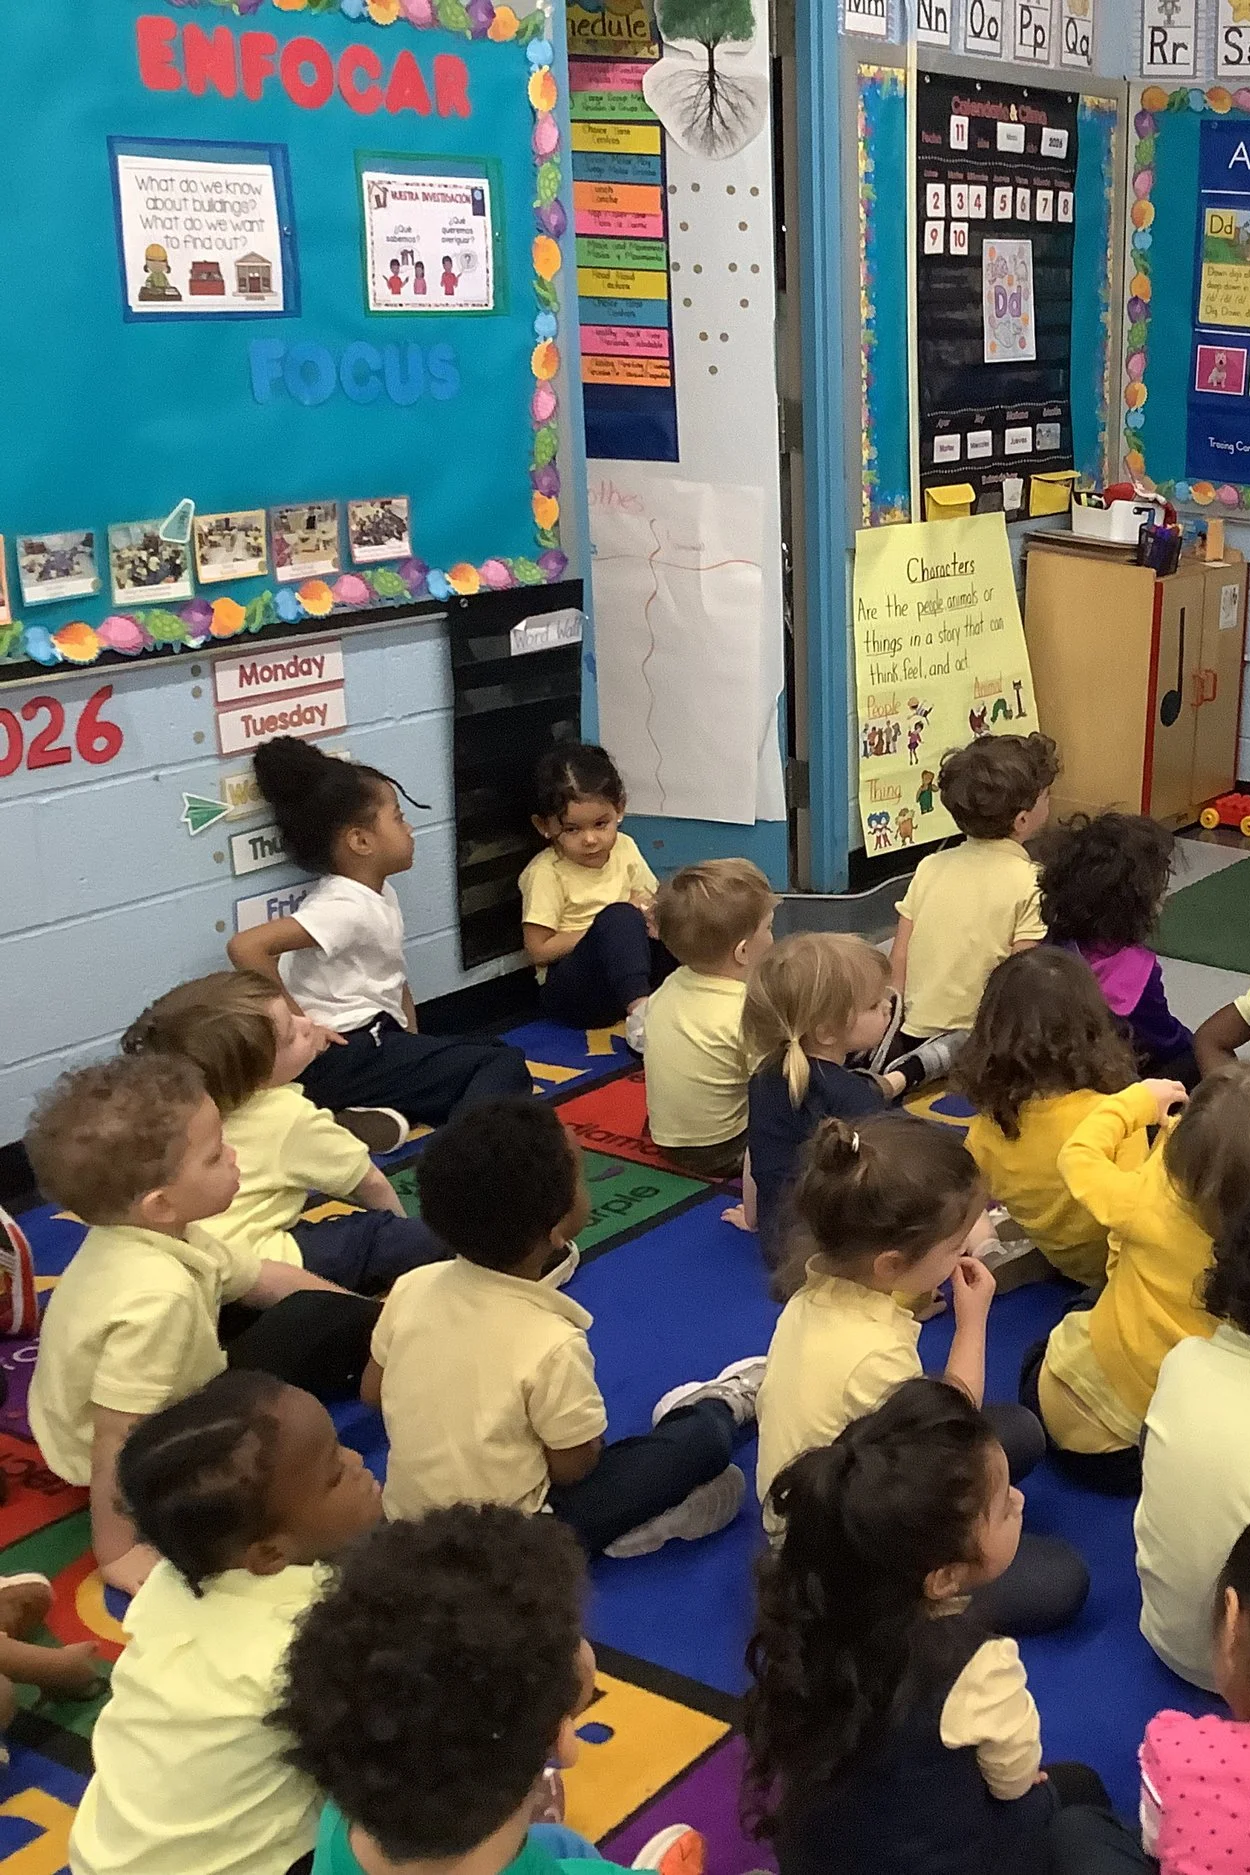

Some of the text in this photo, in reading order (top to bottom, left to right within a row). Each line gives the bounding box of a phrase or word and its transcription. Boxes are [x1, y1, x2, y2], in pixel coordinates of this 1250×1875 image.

[917, 0, 948, 33] Nn
[970, 0, 998, 39] Oo
[1020, 6, 1045, 57] Pp
[1066, 18, 1092, 65] Qq
[1150, 27, 1188, 65] Rr
[136, 15, 471, 118] ENFOCAR
[955, 124, 964, 142] 11
[135, 175, 262, 196] What do we know
[146, 196, 257, 217] about buildings?
[932, 192, 940, 210] 2
[956, 192, 964, 211] 3
[974, 193, 982, 211] 4
[999, 193, 1007, 211] 5
[1020, 194, 1026, 212] 6
[1042, 197, 1049, 214] 7
[1062, 199, 1069, 215] 8
[140, 214, 265, 232] What do we want
[1209, 214, 1234, 236] Dd
[164, 234, 248, 250] to find out?
[930, 228, 938, 245] 9
[953, 229, 966, 248] 10
[994, 285, 1021, 318] Dd
[248, 338, 462, 406] FOCUS
[1208, 437, 1234, 455] Tracing
[906, 552, 975, 583] Characters
[857, 598, 878, 622] Are
[886, 594, 908, 618] the
[983, 587, 994, 602] or
[863, 611, 1004, 658] things in a story that can
[238, 650, 325, 689] Monday
[929, 652, 950, 676] and
[955, 648, 969, 671] act
[867, 692, 901, 720] People
[0, 685, 123, 778] 026
[240, 700, 328, 739] Tuesday
[865, 778, 902, 804] Thing
